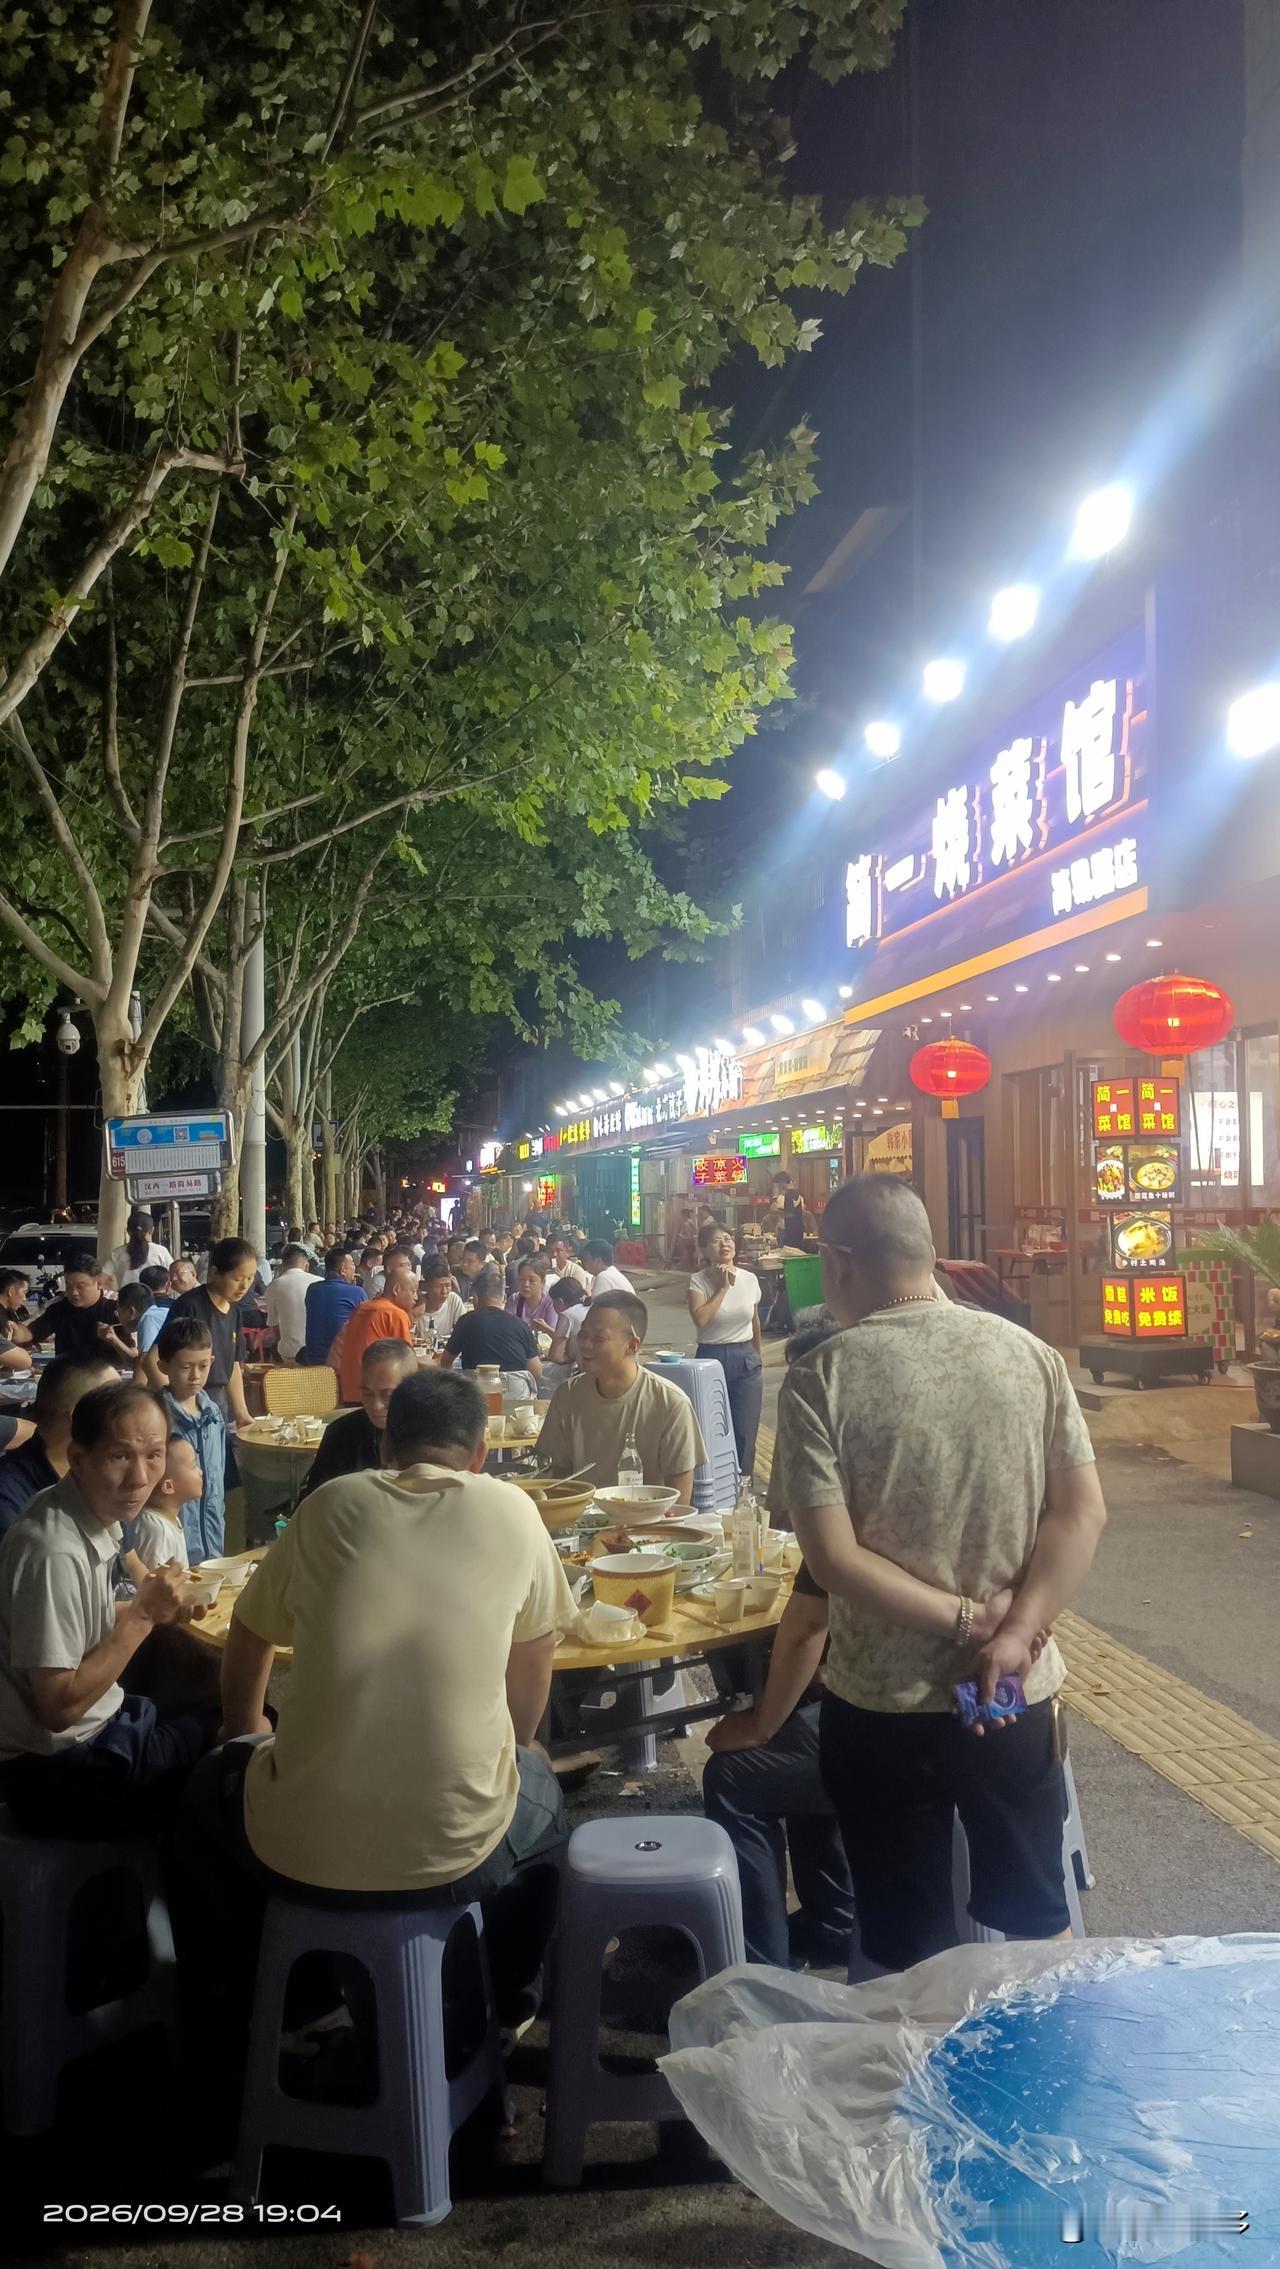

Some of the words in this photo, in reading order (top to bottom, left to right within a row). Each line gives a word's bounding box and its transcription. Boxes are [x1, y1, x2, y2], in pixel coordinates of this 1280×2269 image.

[1097, 1114, 1132, 1132] 菜馆
[1142, 1112, 1175, 1130] 菜馆
[112, 1156, 126, 1168] 615
[1140, 1285, 1178, 1304] 米饭
[1104, 1308, 1130, 1327] 免费吃
[1138, 1309, 1182, 1327] 免费续
